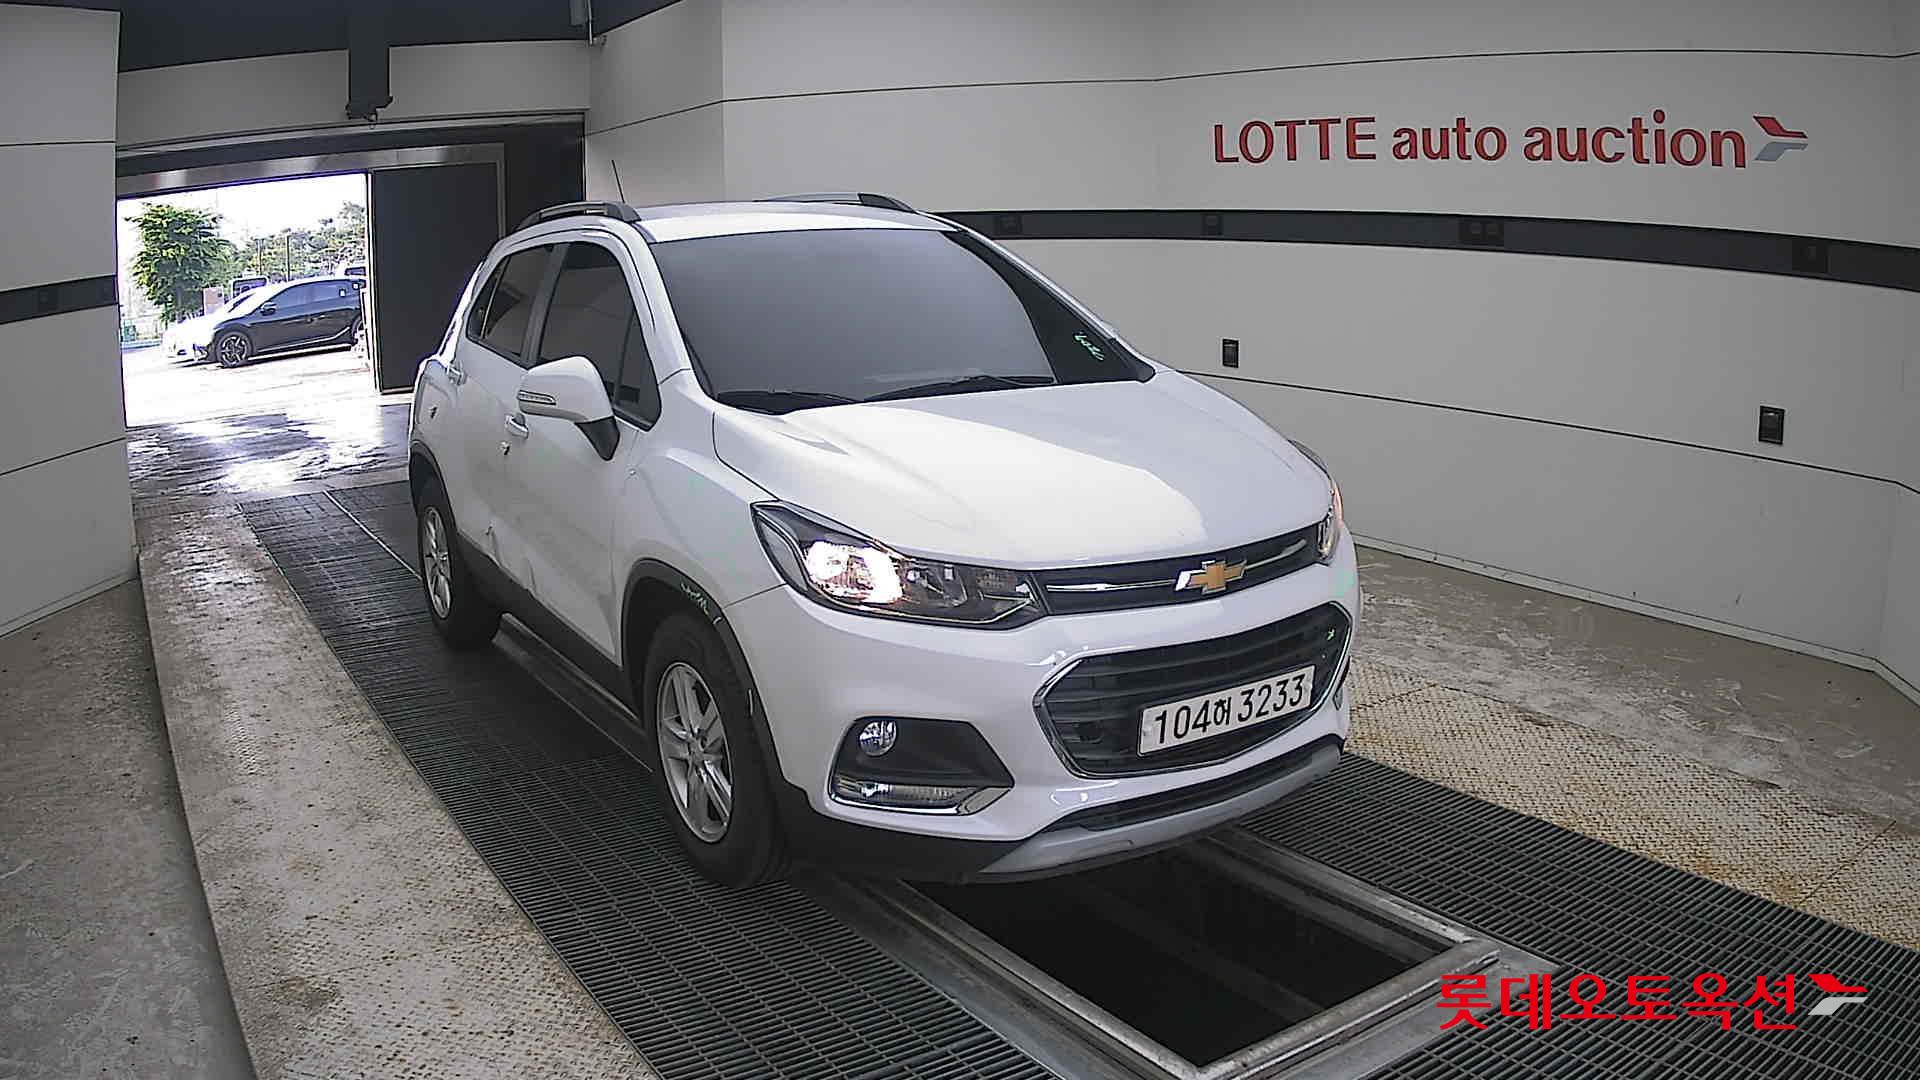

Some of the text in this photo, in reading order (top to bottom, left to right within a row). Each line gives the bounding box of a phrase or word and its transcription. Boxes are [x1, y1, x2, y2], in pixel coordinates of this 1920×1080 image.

[1213, 110, 1747, 168] LOTTE auto auction
[1155, 674, 1306, 744] 104허 3233
